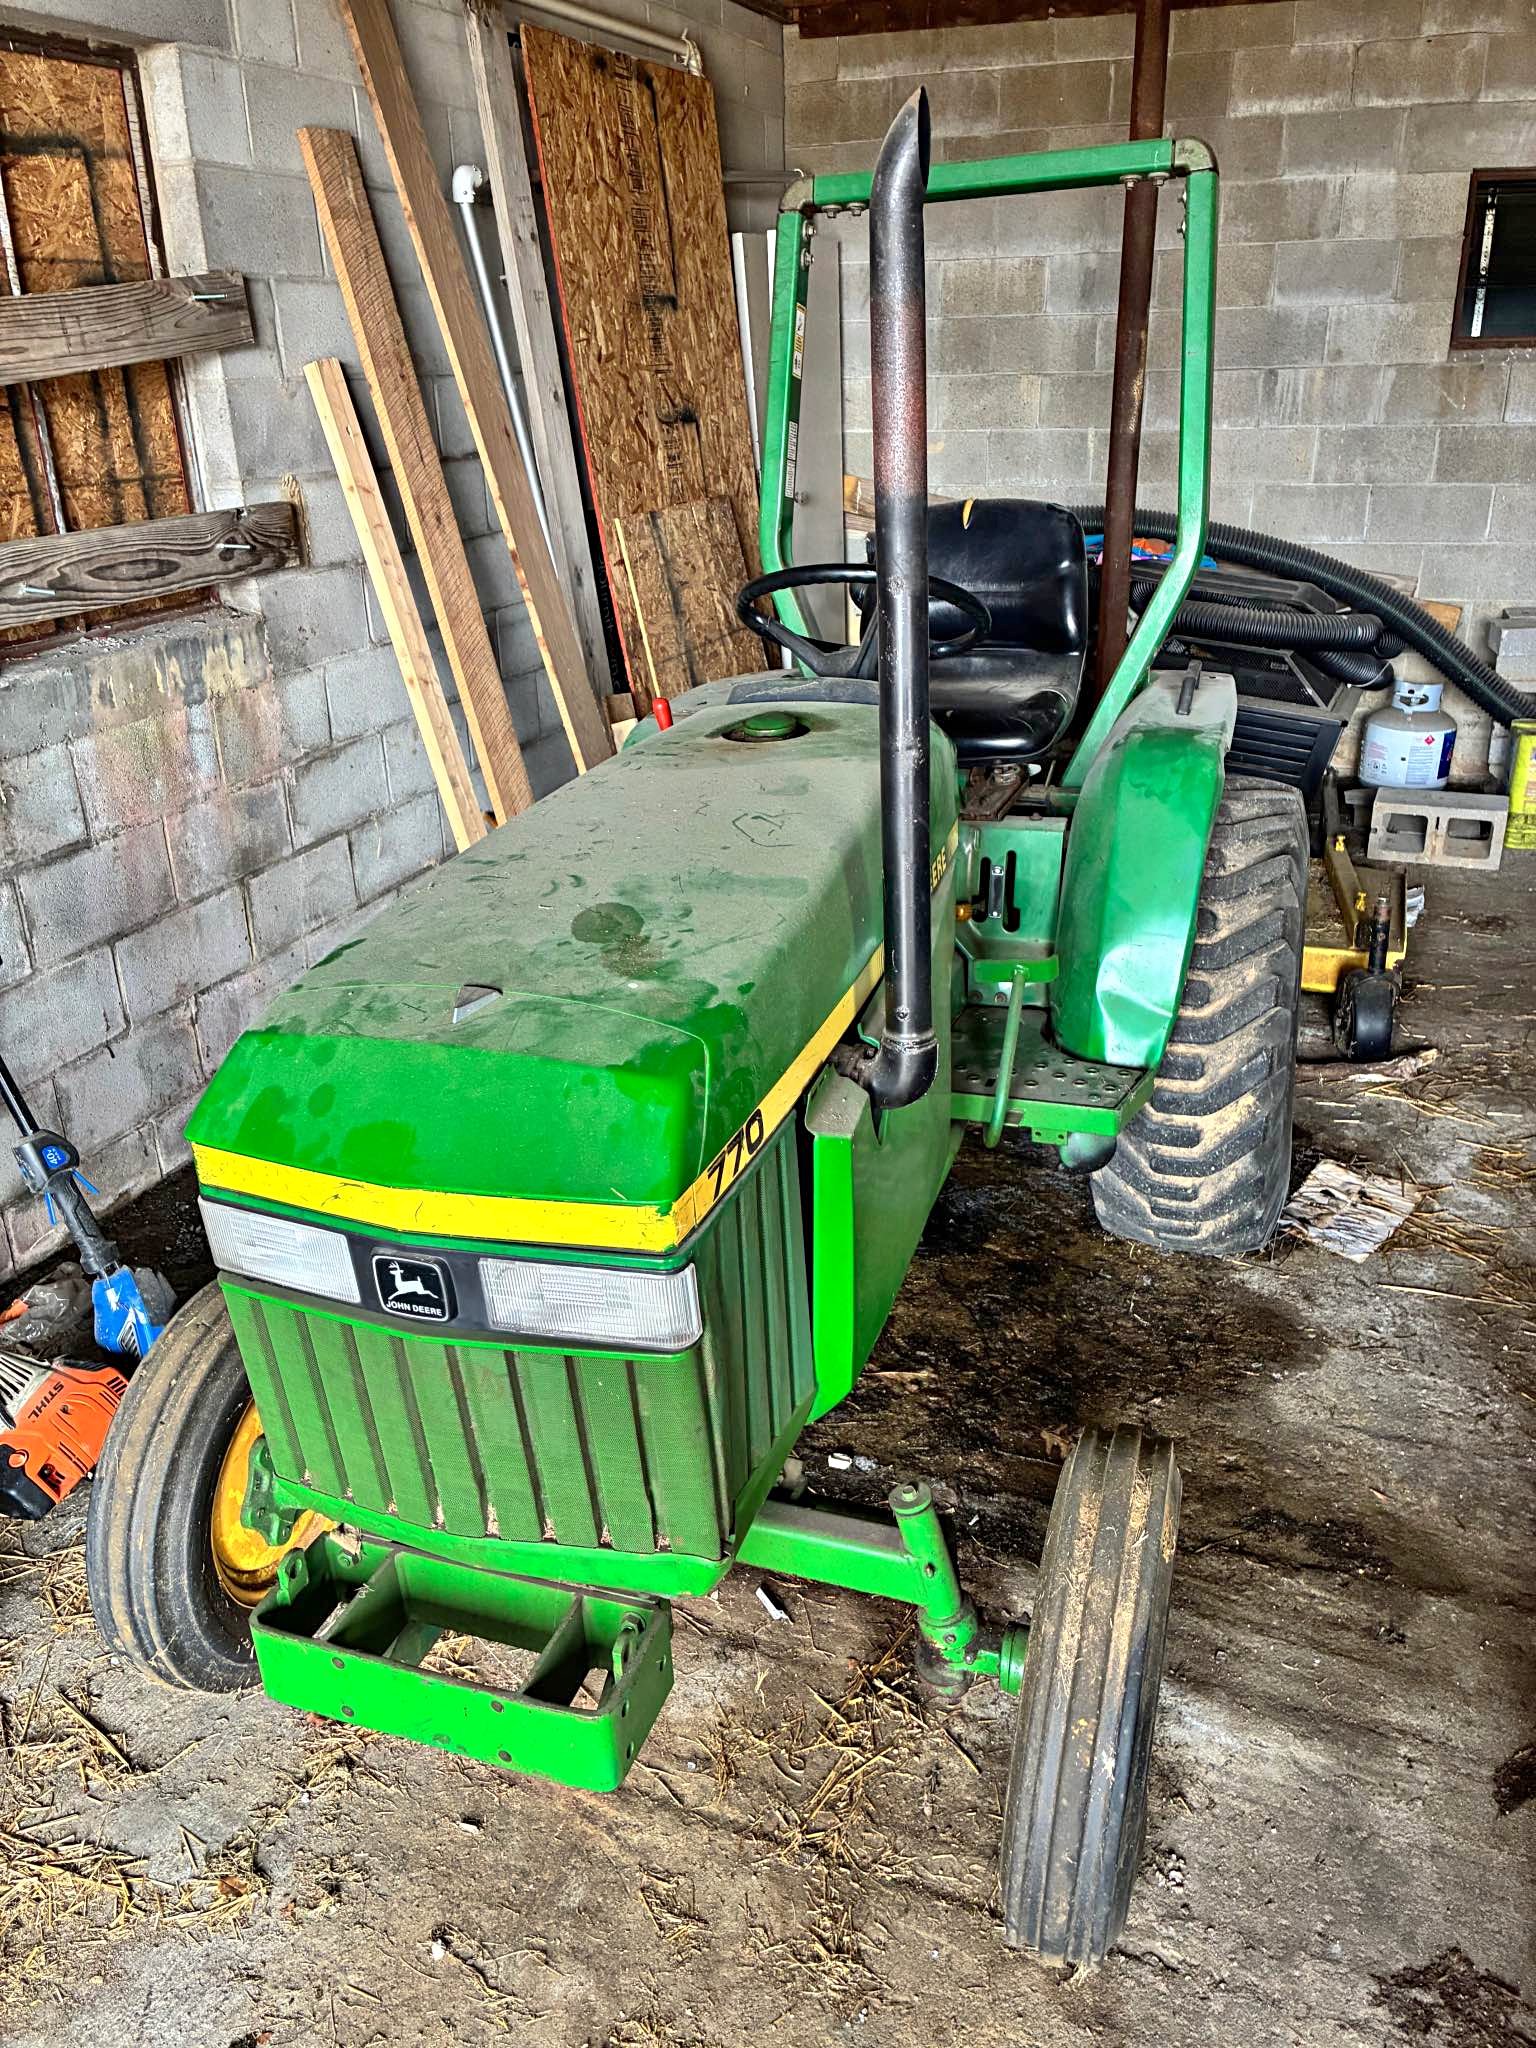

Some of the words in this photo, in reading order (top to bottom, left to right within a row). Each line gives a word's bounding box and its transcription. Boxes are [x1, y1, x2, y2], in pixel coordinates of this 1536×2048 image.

[930, 847, 947, 891] ERE
[707, 1108, 764, 1202] 770
[386, 1301, 411, 1311] JOHN
[412, 1304, 443, 1316] DEERE
[27, 1380, 65, 1419] STIHL
